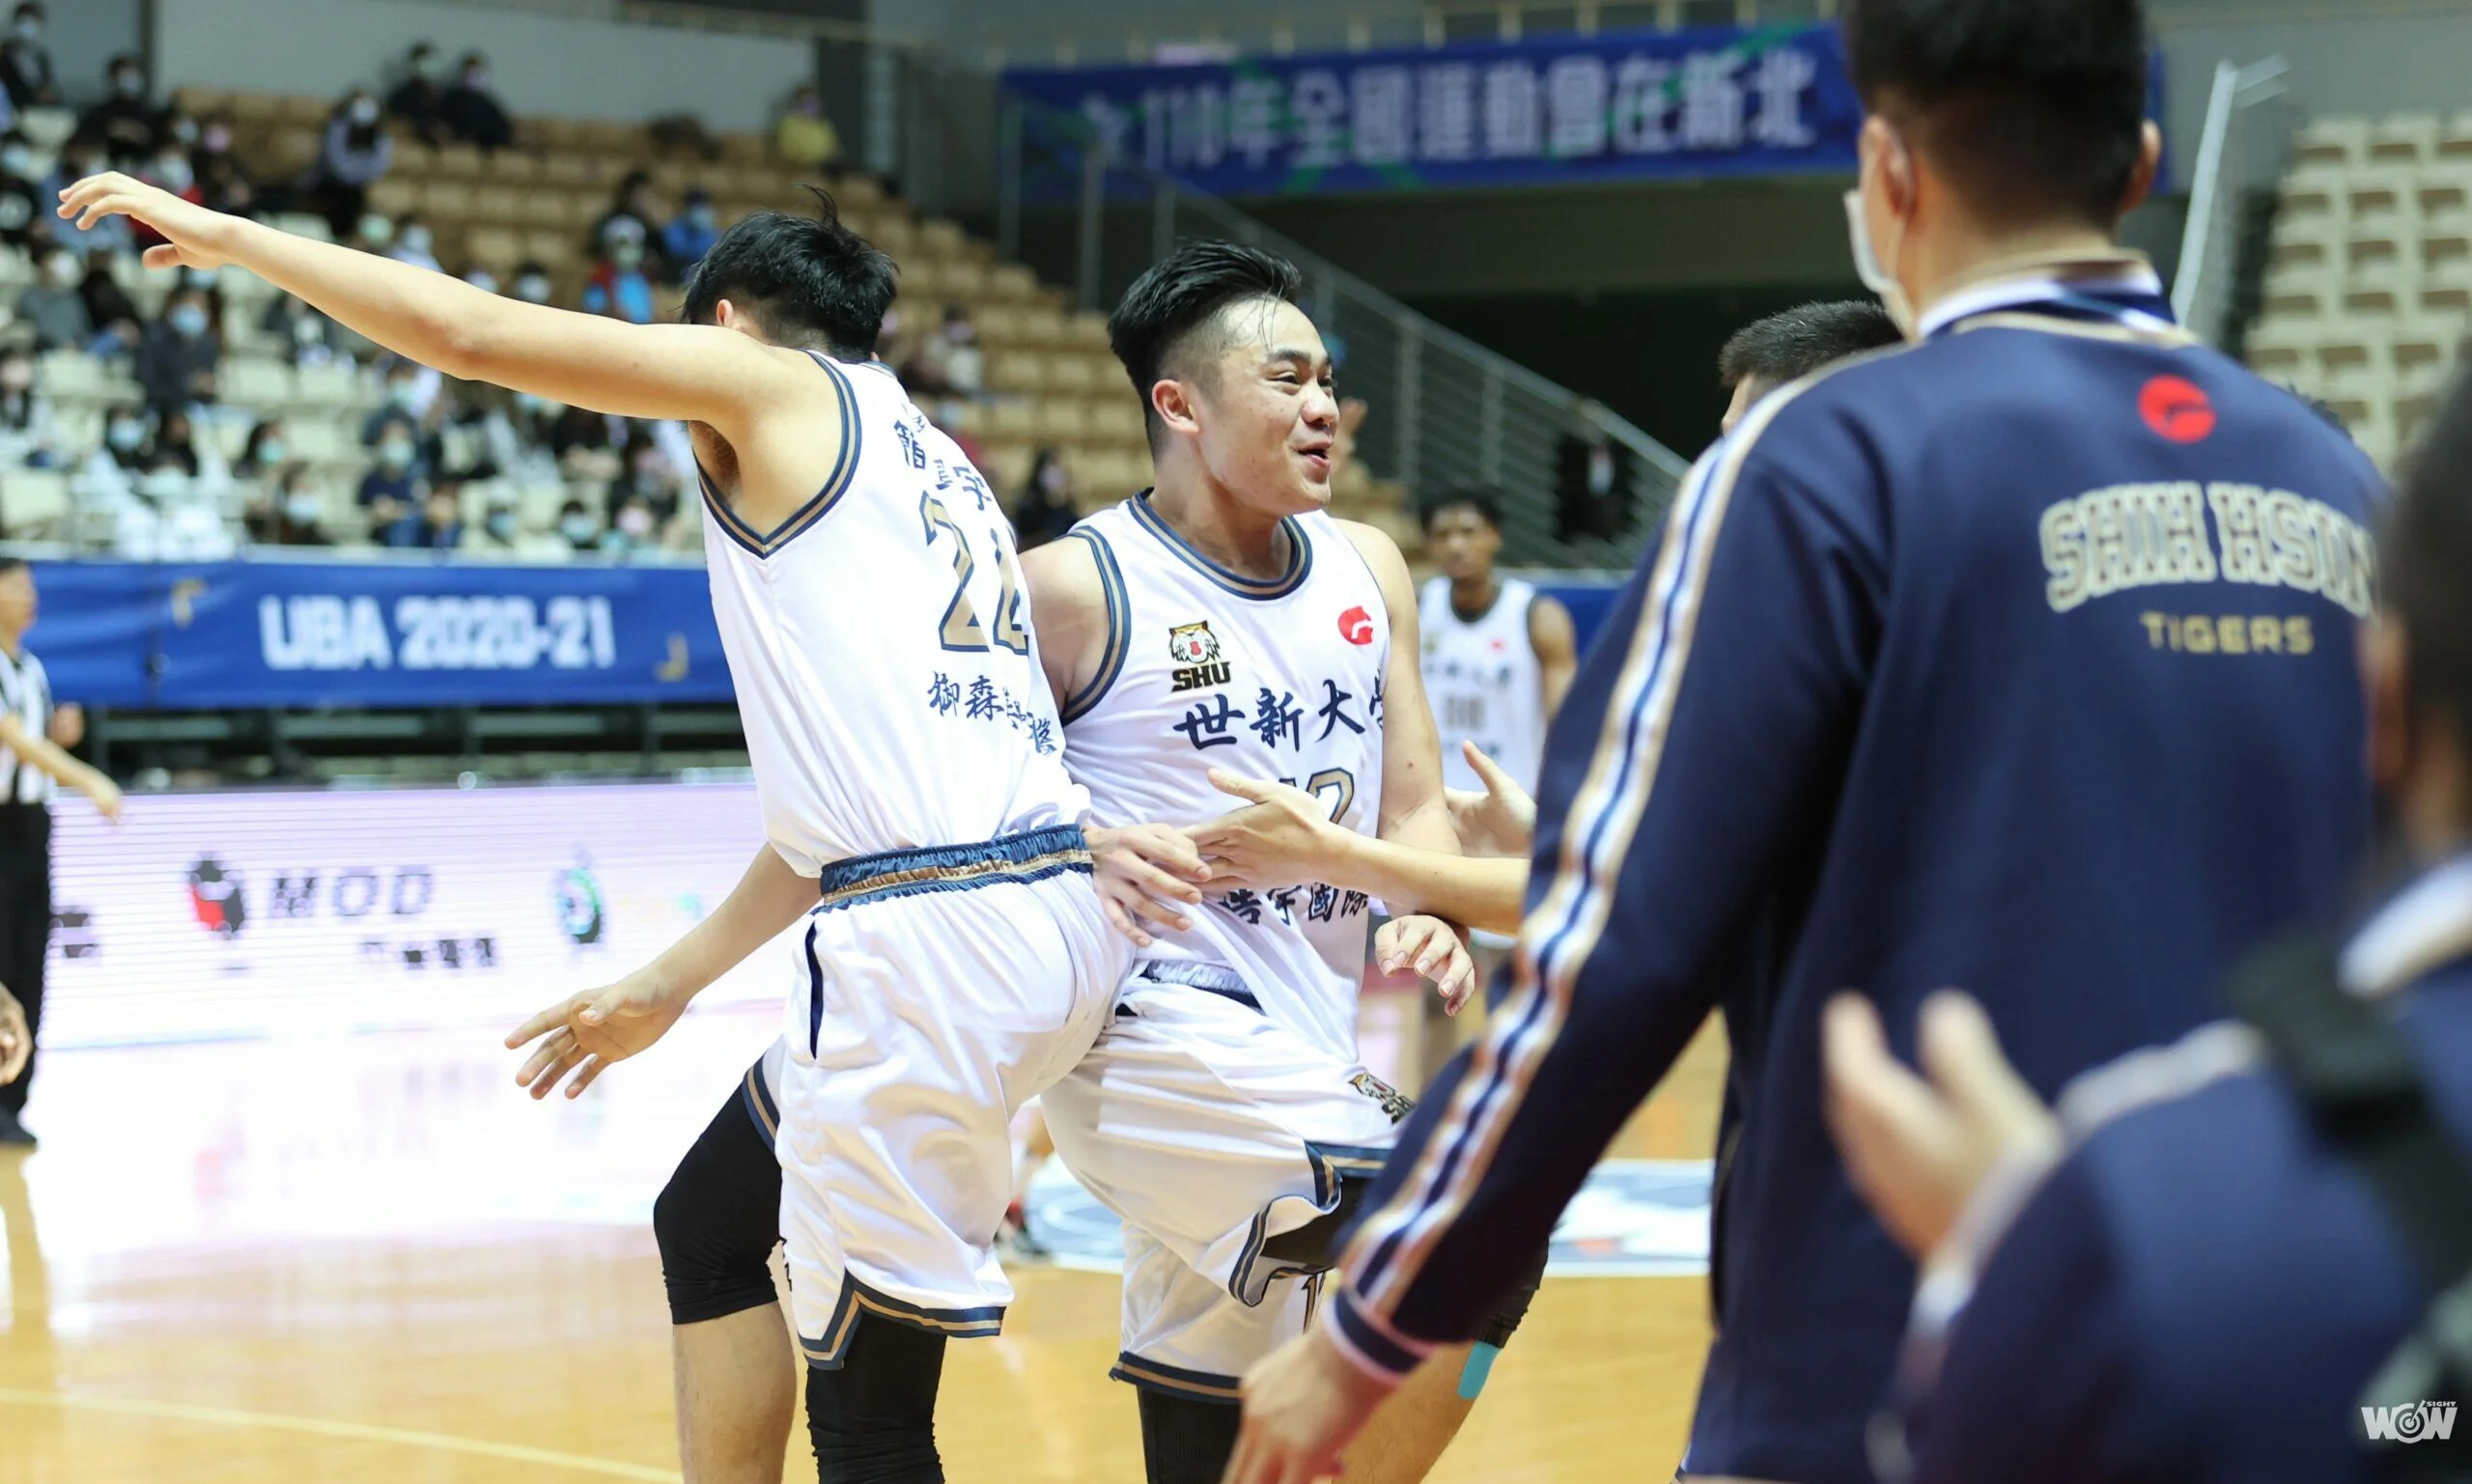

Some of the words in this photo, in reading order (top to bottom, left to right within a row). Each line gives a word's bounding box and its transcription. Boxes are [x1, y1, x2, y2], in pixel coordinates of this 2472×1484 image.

[2039, 480, 2218, 613] SHIH
[258, 594, 390, 671] UBA
[397, 595, 617, 668] 2020-21
[2140, 610, 2315, 656] TIGERS
[1171, 661, 1232, 692] SHU
[1278, 768, 1354, 824] 2
